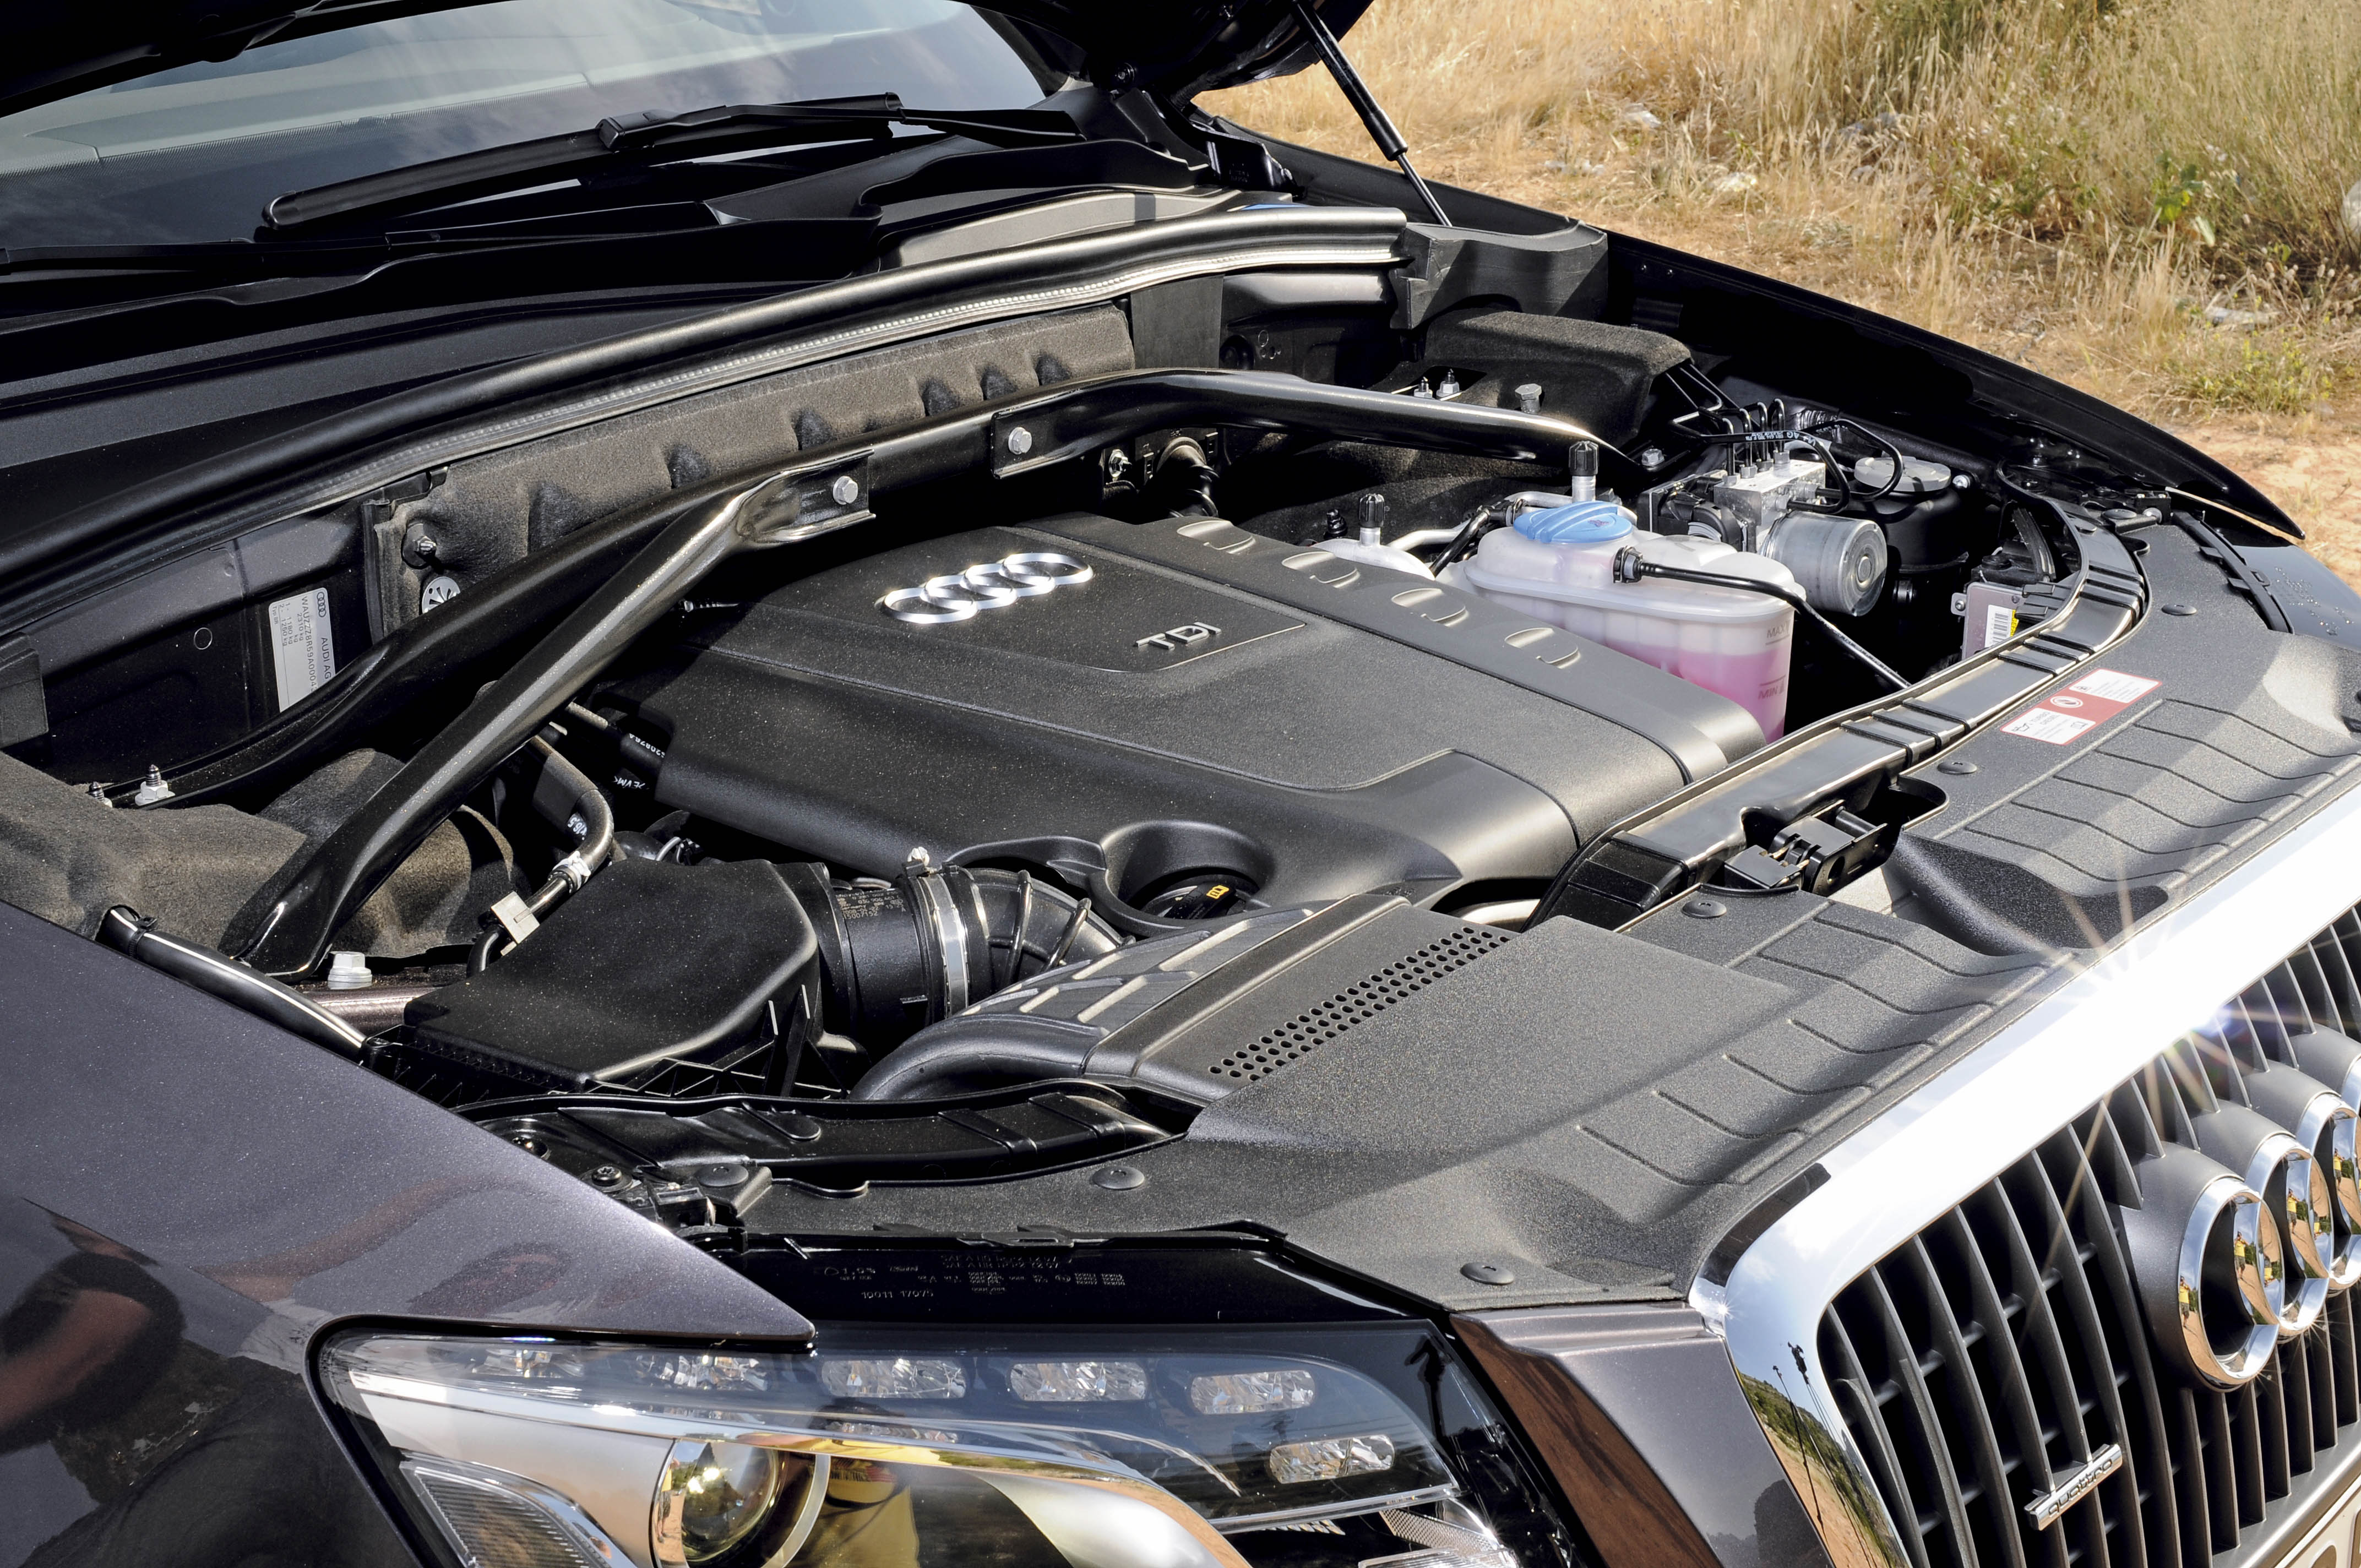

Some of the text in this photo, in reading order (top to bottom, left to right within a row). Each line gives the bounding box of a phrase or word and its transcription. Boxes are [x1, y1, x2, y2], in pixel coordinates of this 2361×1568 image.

[1133, 621, 1222, 650] TDI
[322, 638, 332, 679] AUDI AG
[1758, 686, 1778, 700] MIN
[2048, 1458, 2113, 1515] quattro
